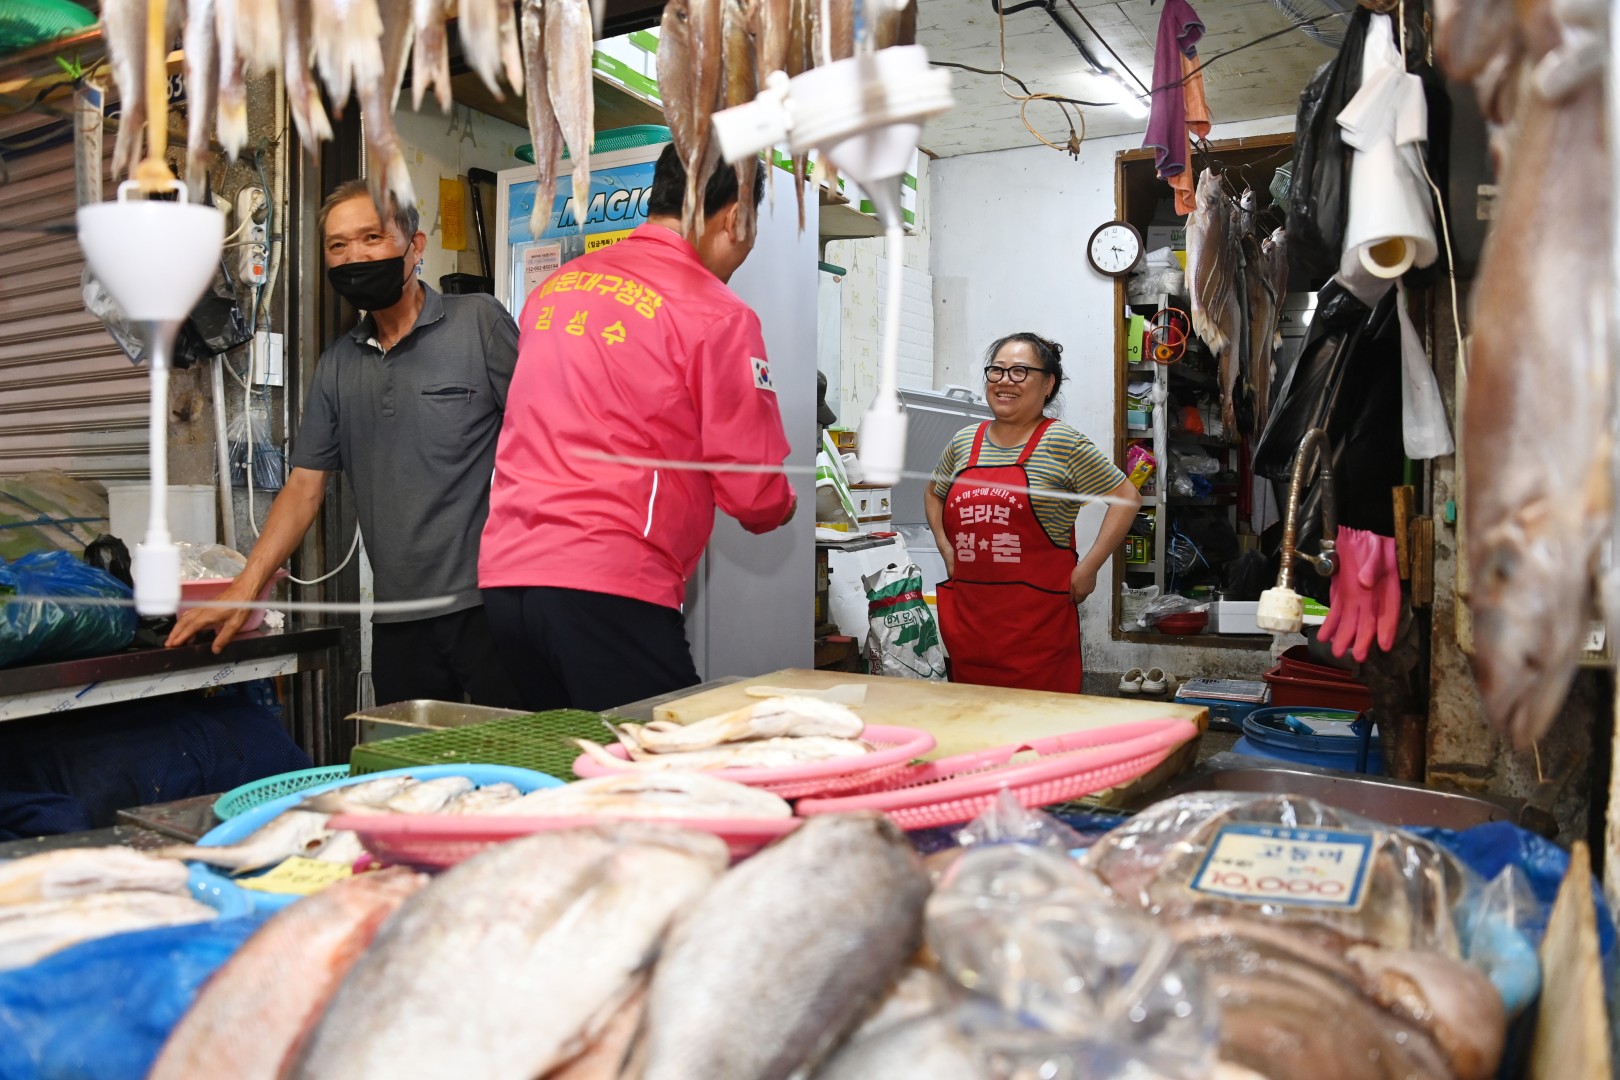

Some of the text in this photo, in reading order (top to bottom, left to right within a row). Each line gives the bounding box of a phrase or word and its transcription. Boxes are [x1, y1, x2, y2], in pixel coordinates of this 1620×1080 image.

[972, 487, 989, 497] 맛에
[959, 504, 1010, 526] 브라보
[1211, 871, 1345, 896] 10,000
